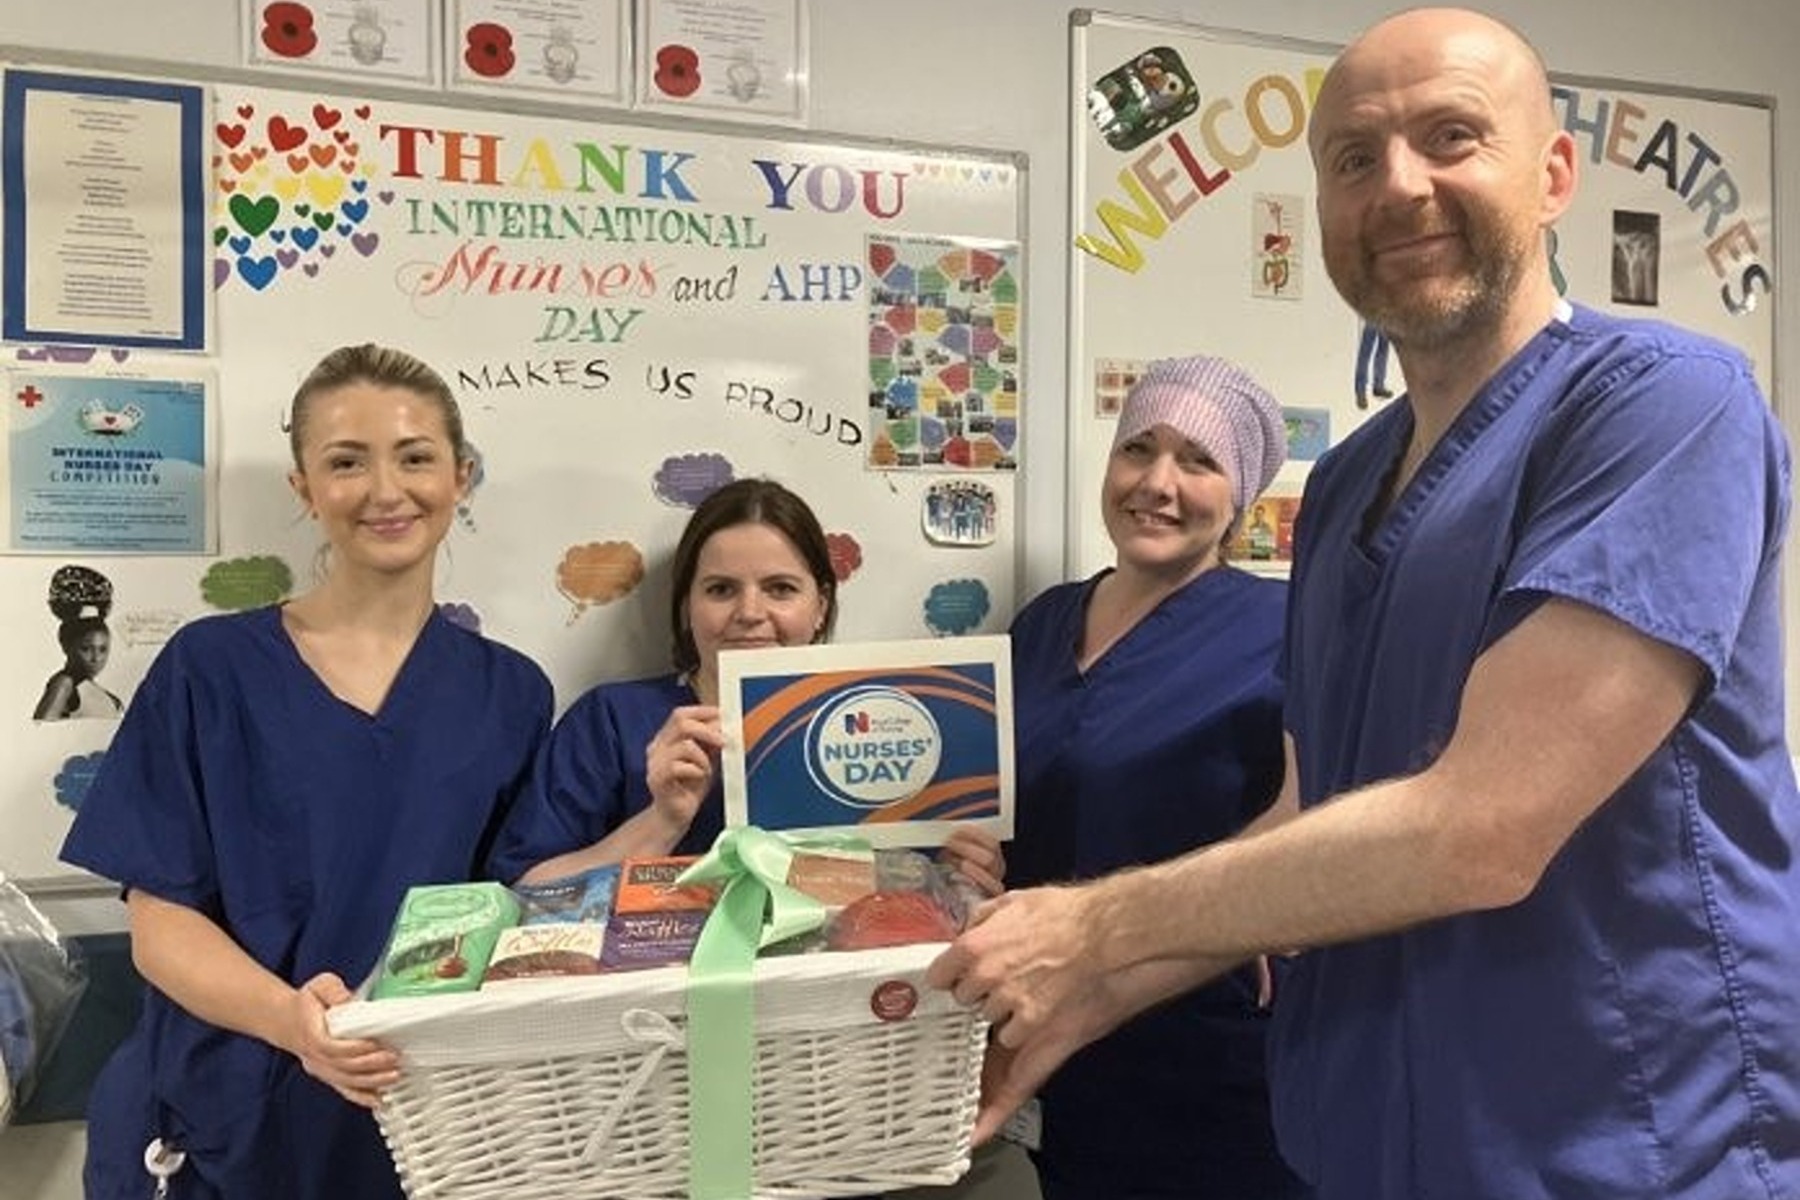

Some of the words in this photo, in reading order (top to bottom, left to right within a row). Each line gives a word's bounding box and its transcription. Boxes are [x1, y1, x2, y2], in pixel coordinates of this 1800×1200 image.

[380, 124, 699, 203] THANK
[752, 159, 909, 219] YOU
[1075, 66, 1326, 275] WELCO
[405, 198, 767, 249] INTERNATIONAL
[396, 240, 660, 306] Nurses
[674, 264, 738, 302] and
[760, 262, 862, 302] AHP
[533, 306, 644, 344] DAY
[457, 358, 611, 391] MAKES
[645, 364, 697, 400] US
[725, 381, 864, 447] PROUD
[51, 447, 163, 460] INTERNATIONAL
[64, 460, 121, 472] NURSES
[824, 737, 932, 761] NURSES'
[844, 759, 914, 785] DAY
